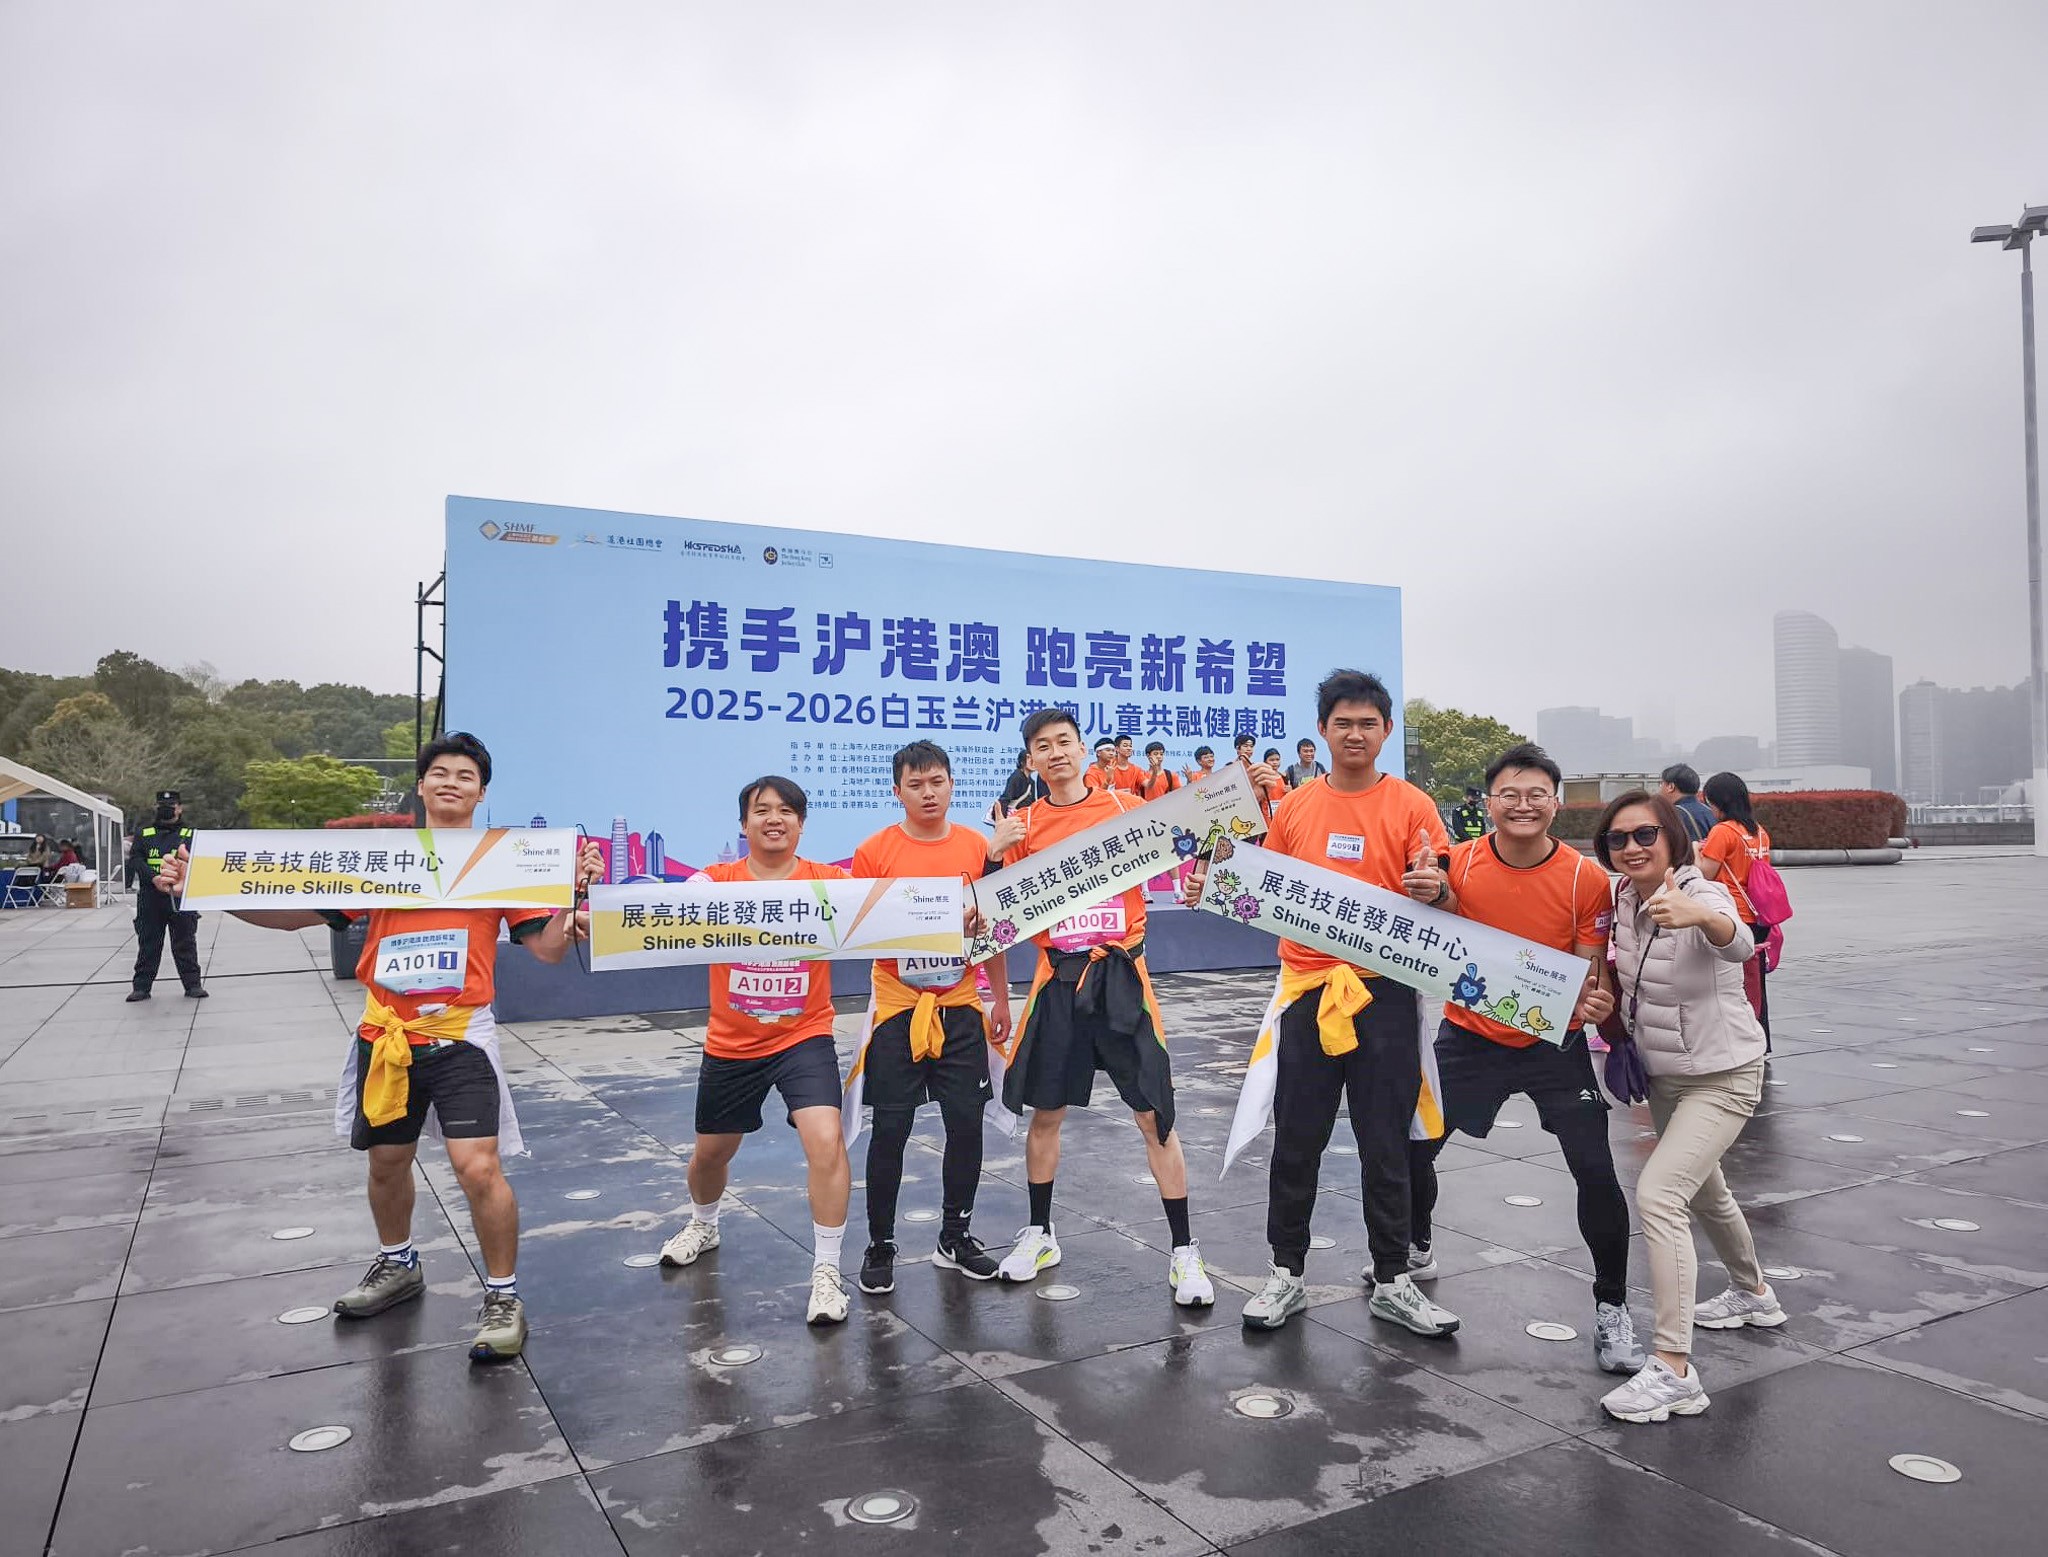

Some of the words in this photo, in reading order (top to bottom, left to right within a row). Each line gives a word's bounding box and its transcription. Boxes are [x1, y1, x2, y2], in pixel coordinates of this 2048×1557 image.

[664, 600, 1000, 684] 携手沪港澳
[1026, 626, 1287, 696] 跑亮新希望
[221, 849, 444, 874] 展亮技能發展中心
[522, 848, 545, 856] Shine
[995, 819, 1167, 911] 展亮技能發展中心
[240, 880, 296, 895] Shine
[302, 881, 354, 895] Skills
[360, 880, 422, 894] Centre
[1023, 894, 1066, 921] Shine
[1067, 873, 1109, 899] Skills
[1111, 847, 1160, 878] Centre
[913, 895, 934, 903] Shine
[621, 898, 838, 929] 展亮技能發展中心
[1056, 914, 1116, 932] A1002
[1260, 869, 1468, 962] 展亮技能發展中心
[643, 935, 696, 951] Shine
[702, 933, 752, 948] Skills
[758, 931, 817, 947] Centre
[1272, 904, 1321, 934] Shine
[1325, 925, 1374, 954] Skills
[1379, 945, 1439, 978] Centre
[385, 952, 453, 972] A1011
[1525, 960, 1550, 977] Shine
[737, 976, 800, 994] A1012
